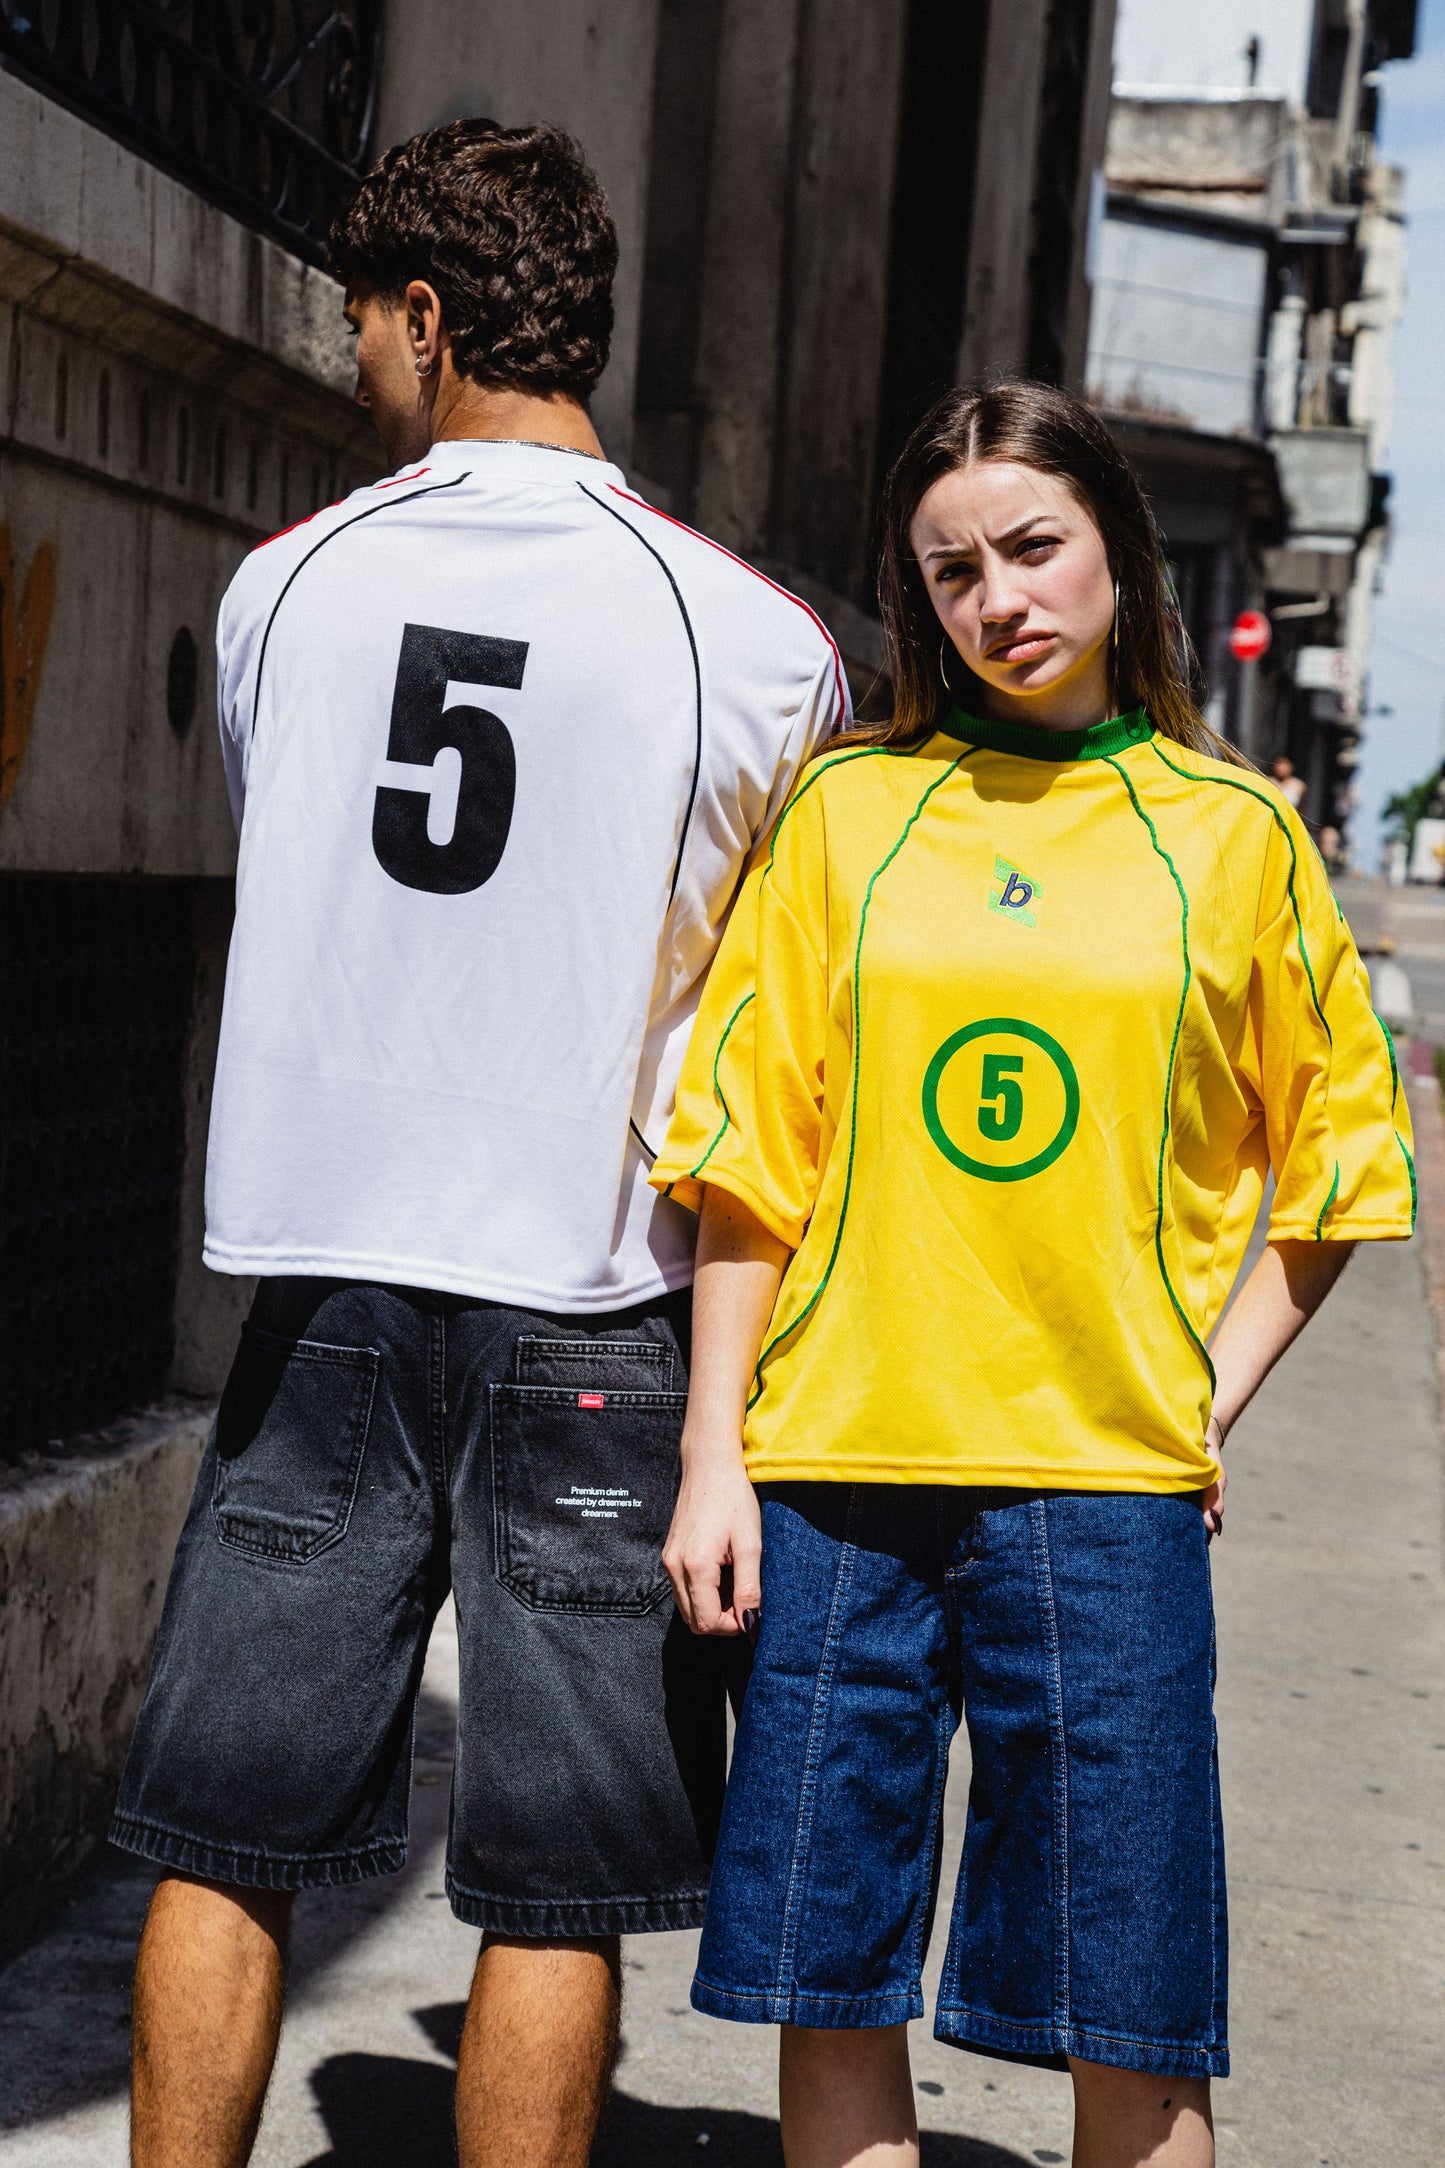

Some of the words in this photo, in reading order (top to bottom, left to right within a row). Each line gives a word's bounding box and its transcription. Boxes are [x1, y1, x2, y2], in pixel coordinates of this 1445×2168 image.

[372, 622, 530, 896] 5
[999, 872, 1033, 908] b
[978, 1054, 1024, 1142] 5
[571, 1486, 606, 1496] Premium
[606, 1488, 629, 1496] denim
[555, 1498, 586, 1506] created
[586, 1498, 598, 1508] by
[598, 1498, 632, 1507] dreamers
[632, 1499, 643, 1508] for
[581, 1509, 619, 1518] dreamers.
